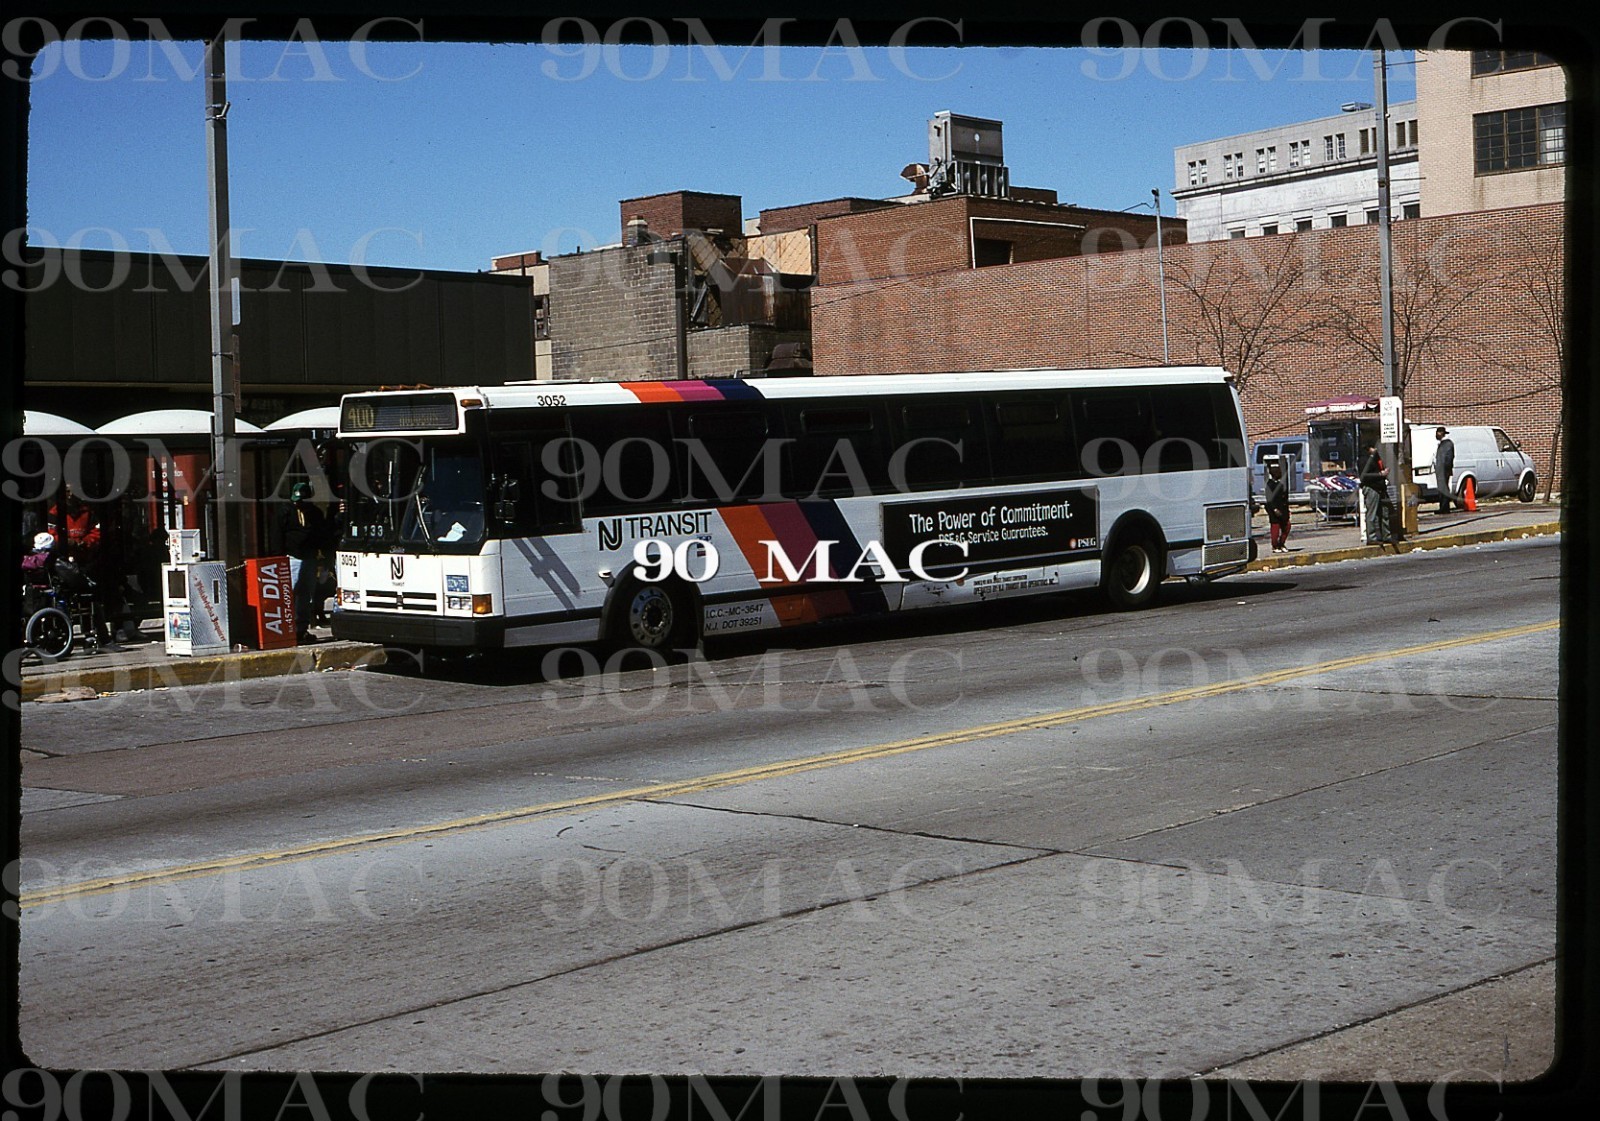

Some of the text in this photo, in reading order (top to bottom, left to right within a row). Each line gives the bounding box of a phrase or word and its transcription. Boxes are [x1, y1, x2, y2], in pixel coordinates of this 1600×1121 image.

[536, 395, 567, 407] 3052
[908, 500, 1074, 534] The Power of Commitment.
[598, 511, 713, 552] NJ TRANSIT
[967, 529, 1000, 545] Service
[1001, 525, 1049, 541] Guarantees.
[341, 554, 358, 567] 3052
[257, 563, 284, 635] AL DÍA
[704, 616, 763, 632] N.J. DOT 39251
